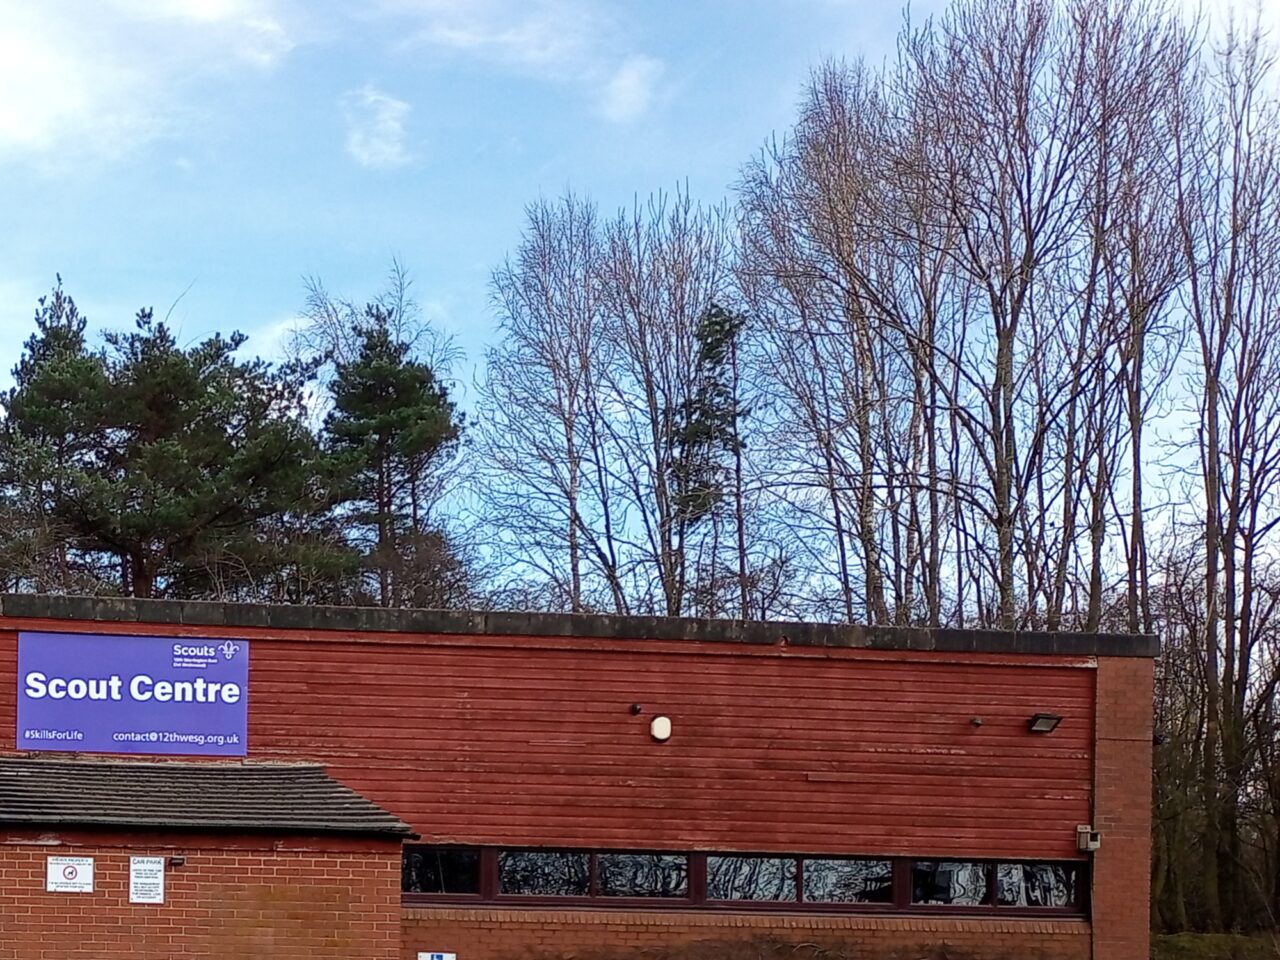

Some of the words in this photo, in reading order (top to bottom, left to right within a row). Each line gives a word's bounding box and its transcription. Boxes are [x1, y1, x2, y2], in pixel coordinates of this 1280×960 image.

[173, 644, 216, 657] Scouts
[24, 671, 122, 701] Scout
[129, 674, 241, 703] Centre
[24, 729, 83, 740] #SkillsForLife
[112, 731, 240, 745] contact@12thwesg.org.uk
